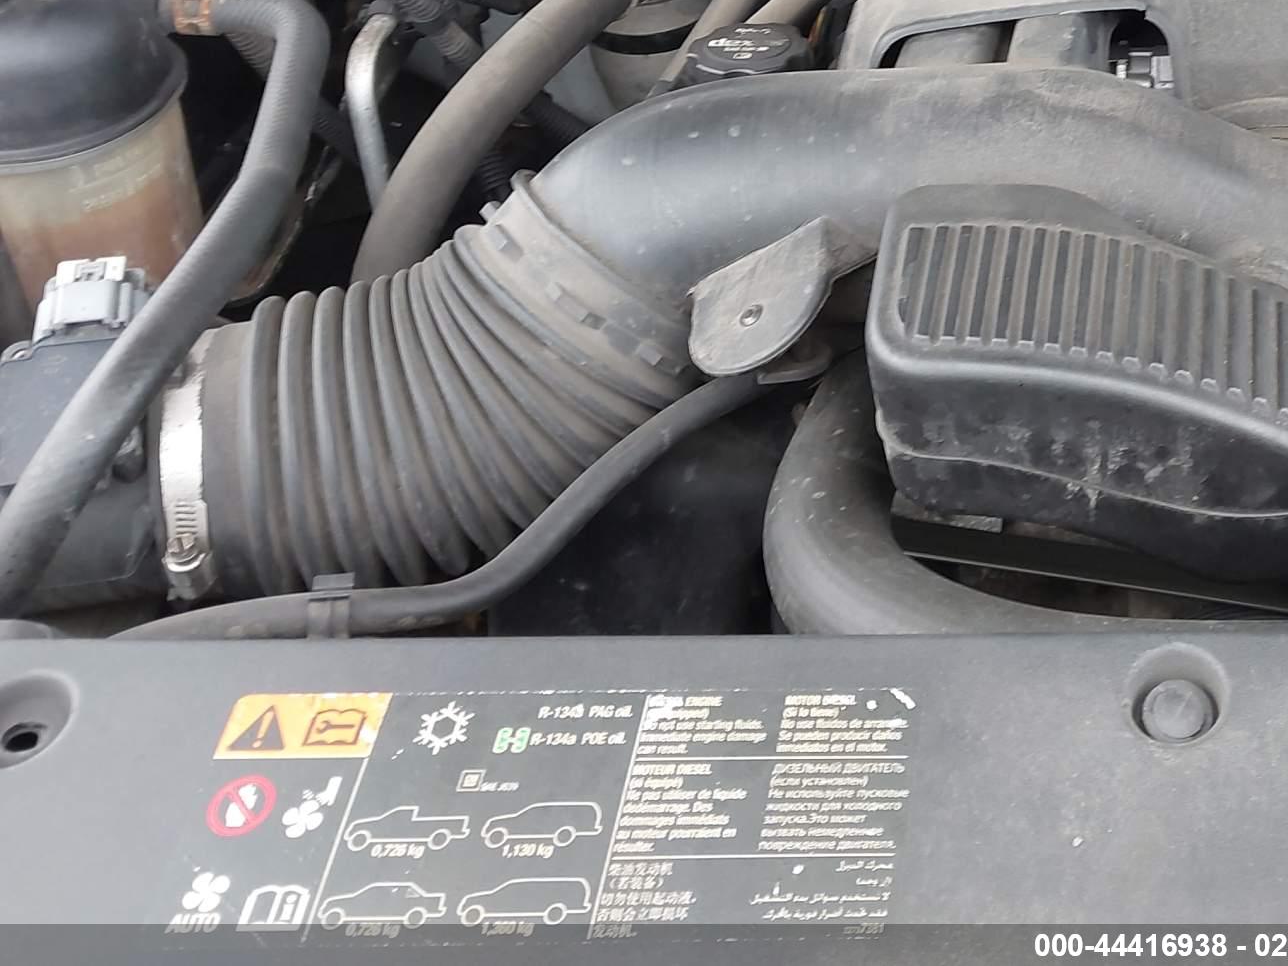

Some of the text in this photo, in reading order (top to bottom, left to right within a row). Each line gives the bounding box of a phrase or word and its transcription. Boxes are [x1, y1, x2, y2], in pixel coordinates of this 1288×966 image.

[588, 705, 615, 718] PAG
[529, 732, 577, 745] R-134a
[580, 732, 608, 745] POE
[407, 843, 425, 859] kg
[536, 843, 554, 859] kg
[164, 913, 221, 934] AUTO
